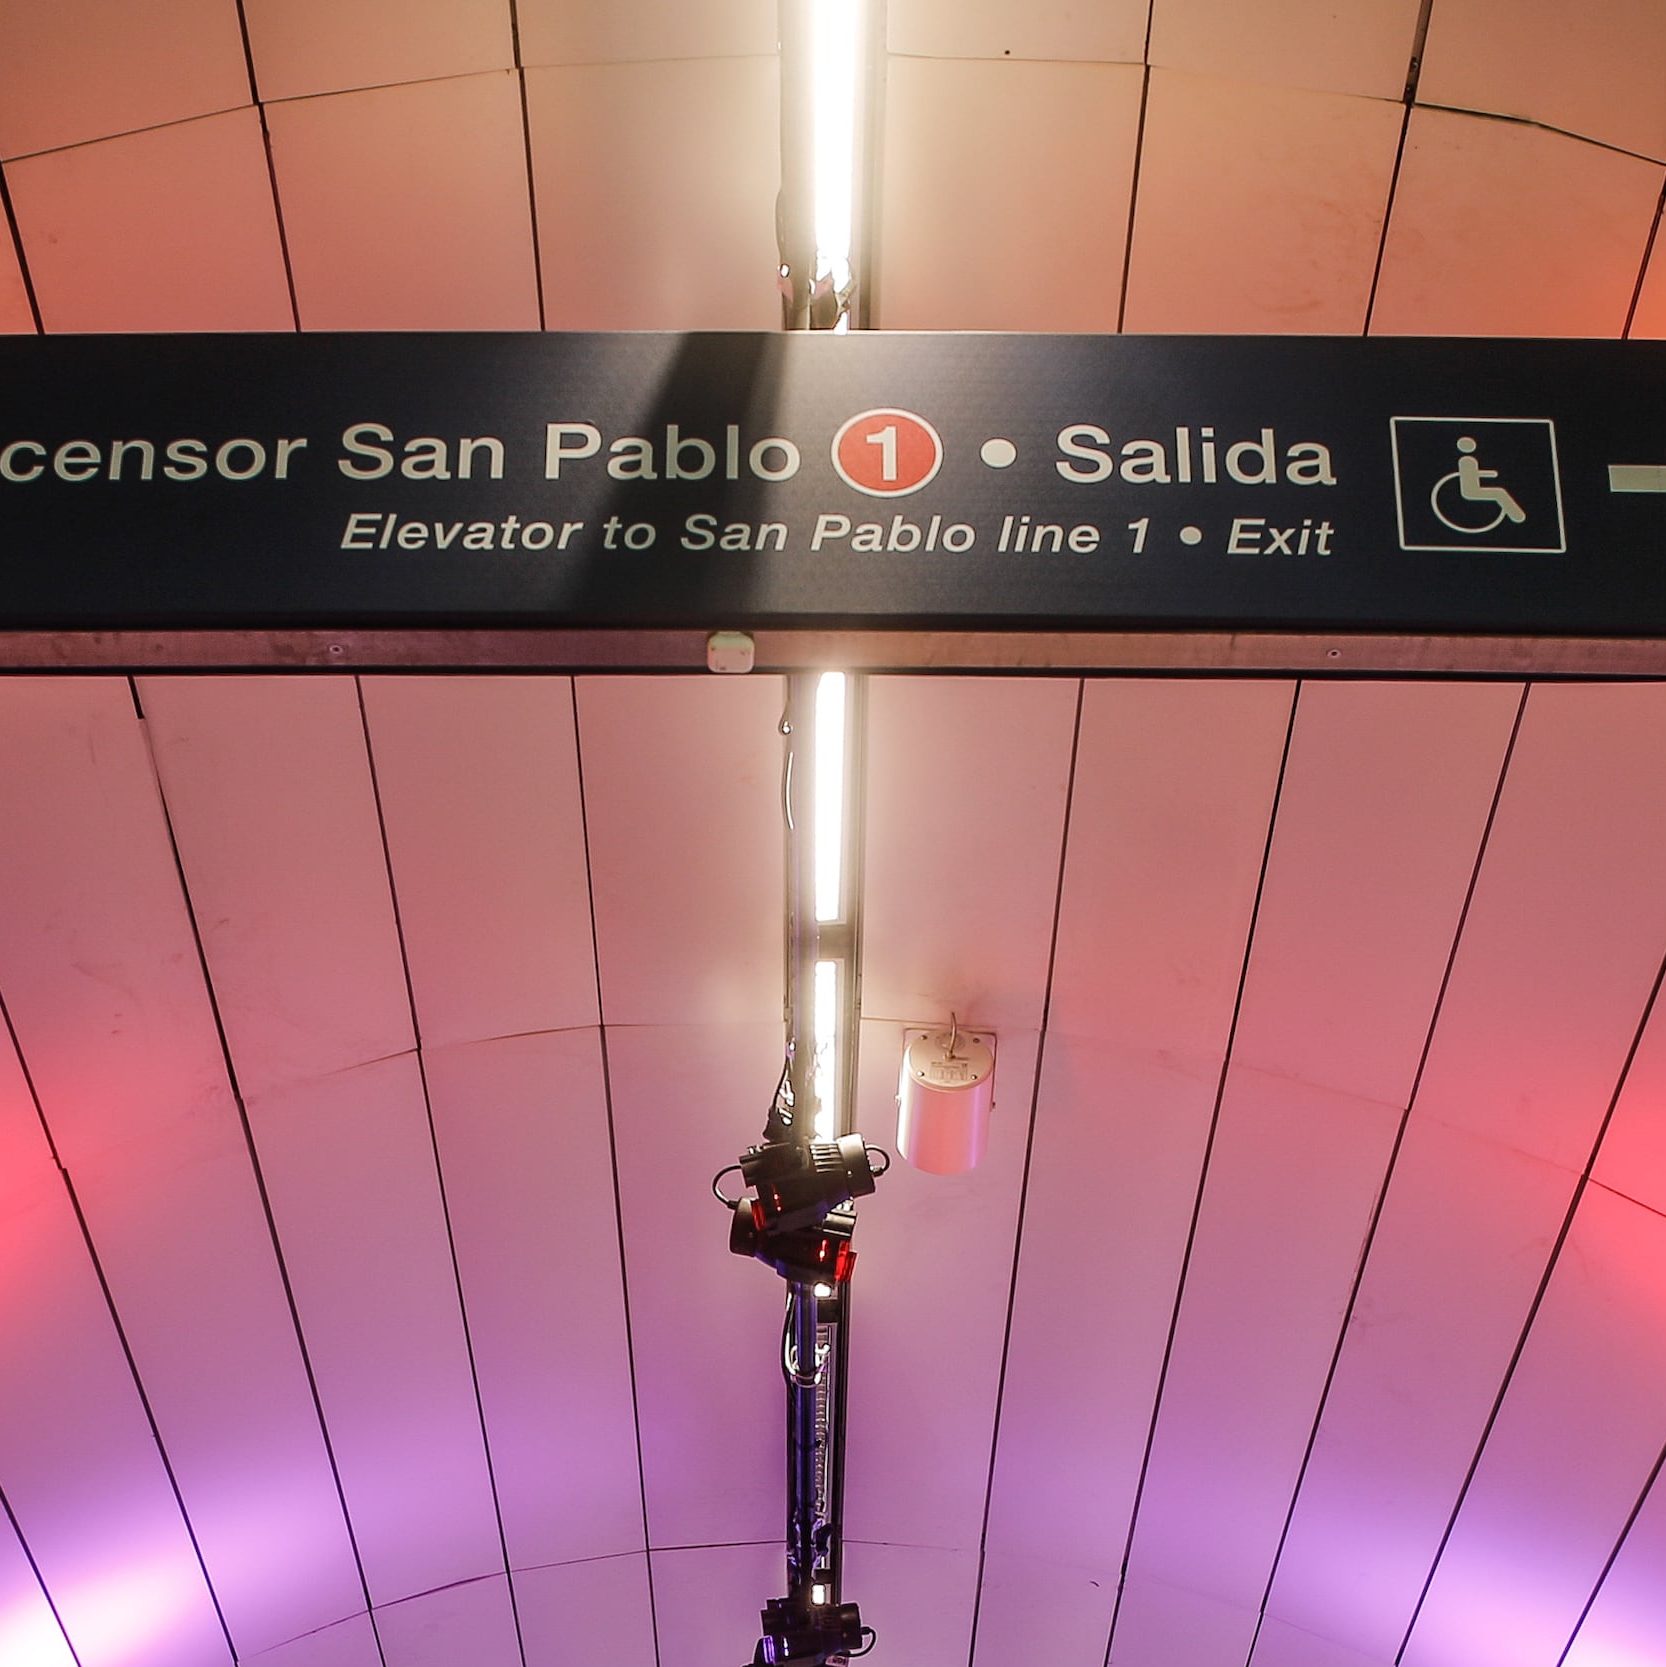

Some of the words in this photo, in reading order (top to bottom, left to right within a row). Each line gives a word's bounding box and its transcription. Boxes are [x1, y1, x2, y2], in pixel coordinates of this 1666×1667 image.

[337, 422, 506, 481] San
[544, 422, 802, 481] Pablo
[865, 425, 898, 482] 1
[1055, 423, 1338, 485] Salida
[340, 513, 585, 551] Elevator
[602, 515, 656, 550] to
[680, 514, 789, 552] San
[810, 515, 976, 553] Pablo
[997, 516, 1101, 554] line
[1127, 517, 1151, 554] 1
[1226, 517, 1336, 556] Exit
